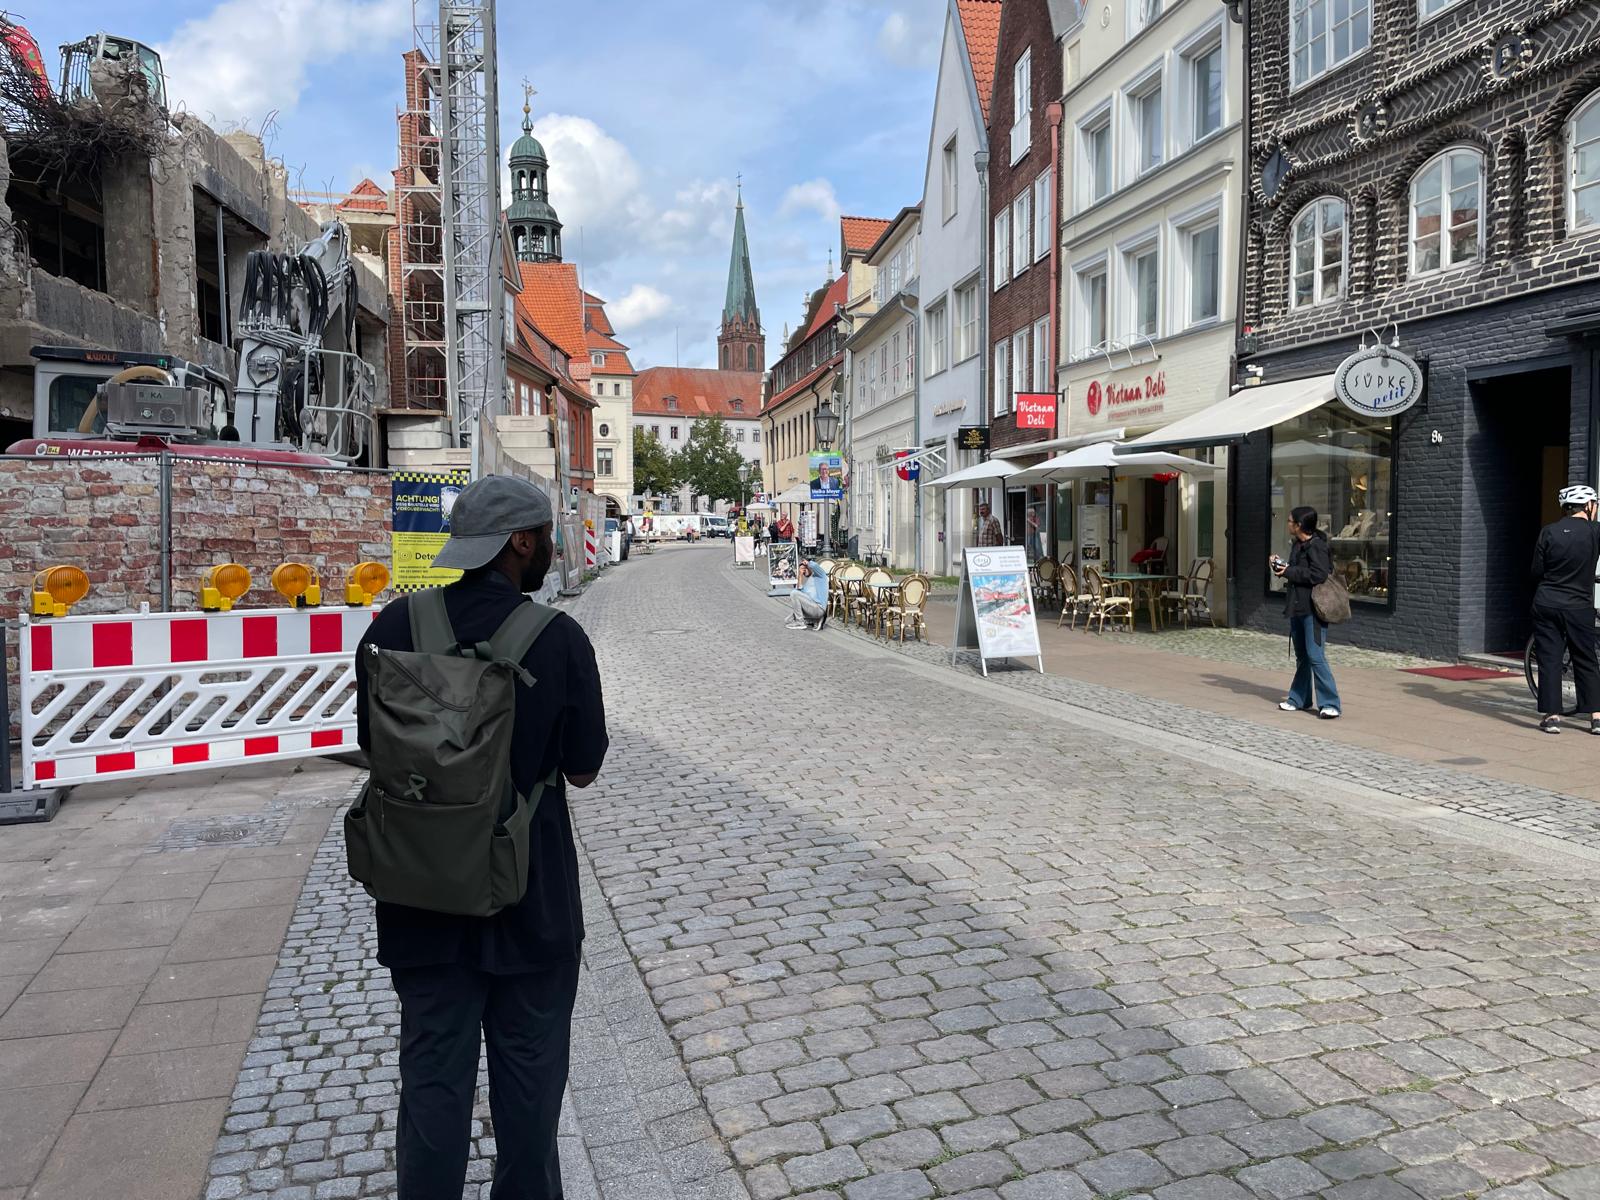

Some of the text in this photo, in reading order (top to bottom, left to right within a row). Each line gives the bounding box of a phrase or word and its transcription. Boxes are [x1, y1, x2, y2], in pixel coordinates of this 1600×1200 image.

[1145, 371, 1165, 398] Deli
[1373, 387, 1406, 409] petit
[1019, 401, 1055, 412] Vietnam
[1027, 414, 1045, 425] Deli
[396, 494, 440, 504] ACHTUNG!
[415, 552, 438, 561] Dete
